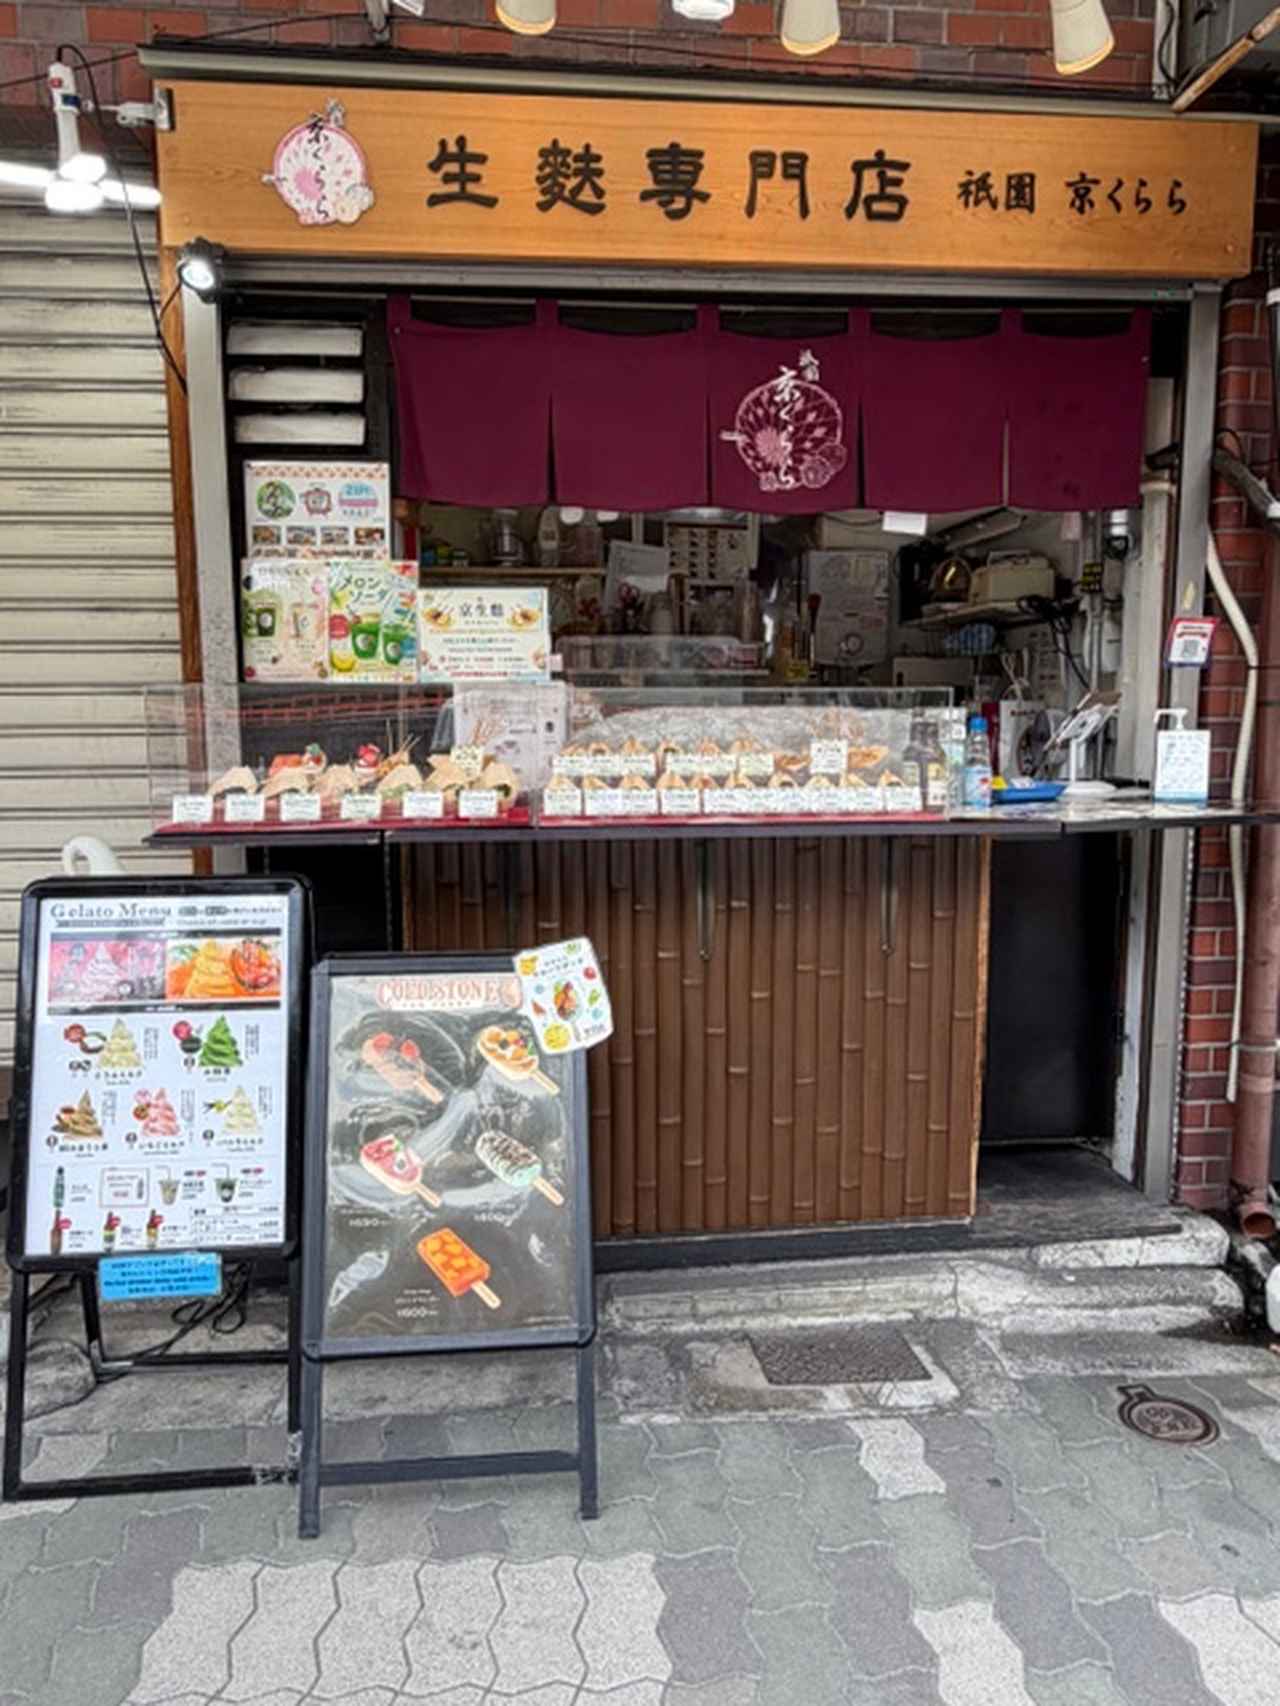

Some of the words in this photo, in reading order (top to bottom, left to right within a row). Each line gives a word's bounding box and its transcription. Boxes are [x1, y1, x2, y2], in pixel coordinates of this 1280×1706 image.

[426, 133, 912, 222] 生麩専門店
[1065, 171, 1189, 216] 京くらら
[50, 903, 113, 918] Gelato
[118, 902, 172, 918] Menu
